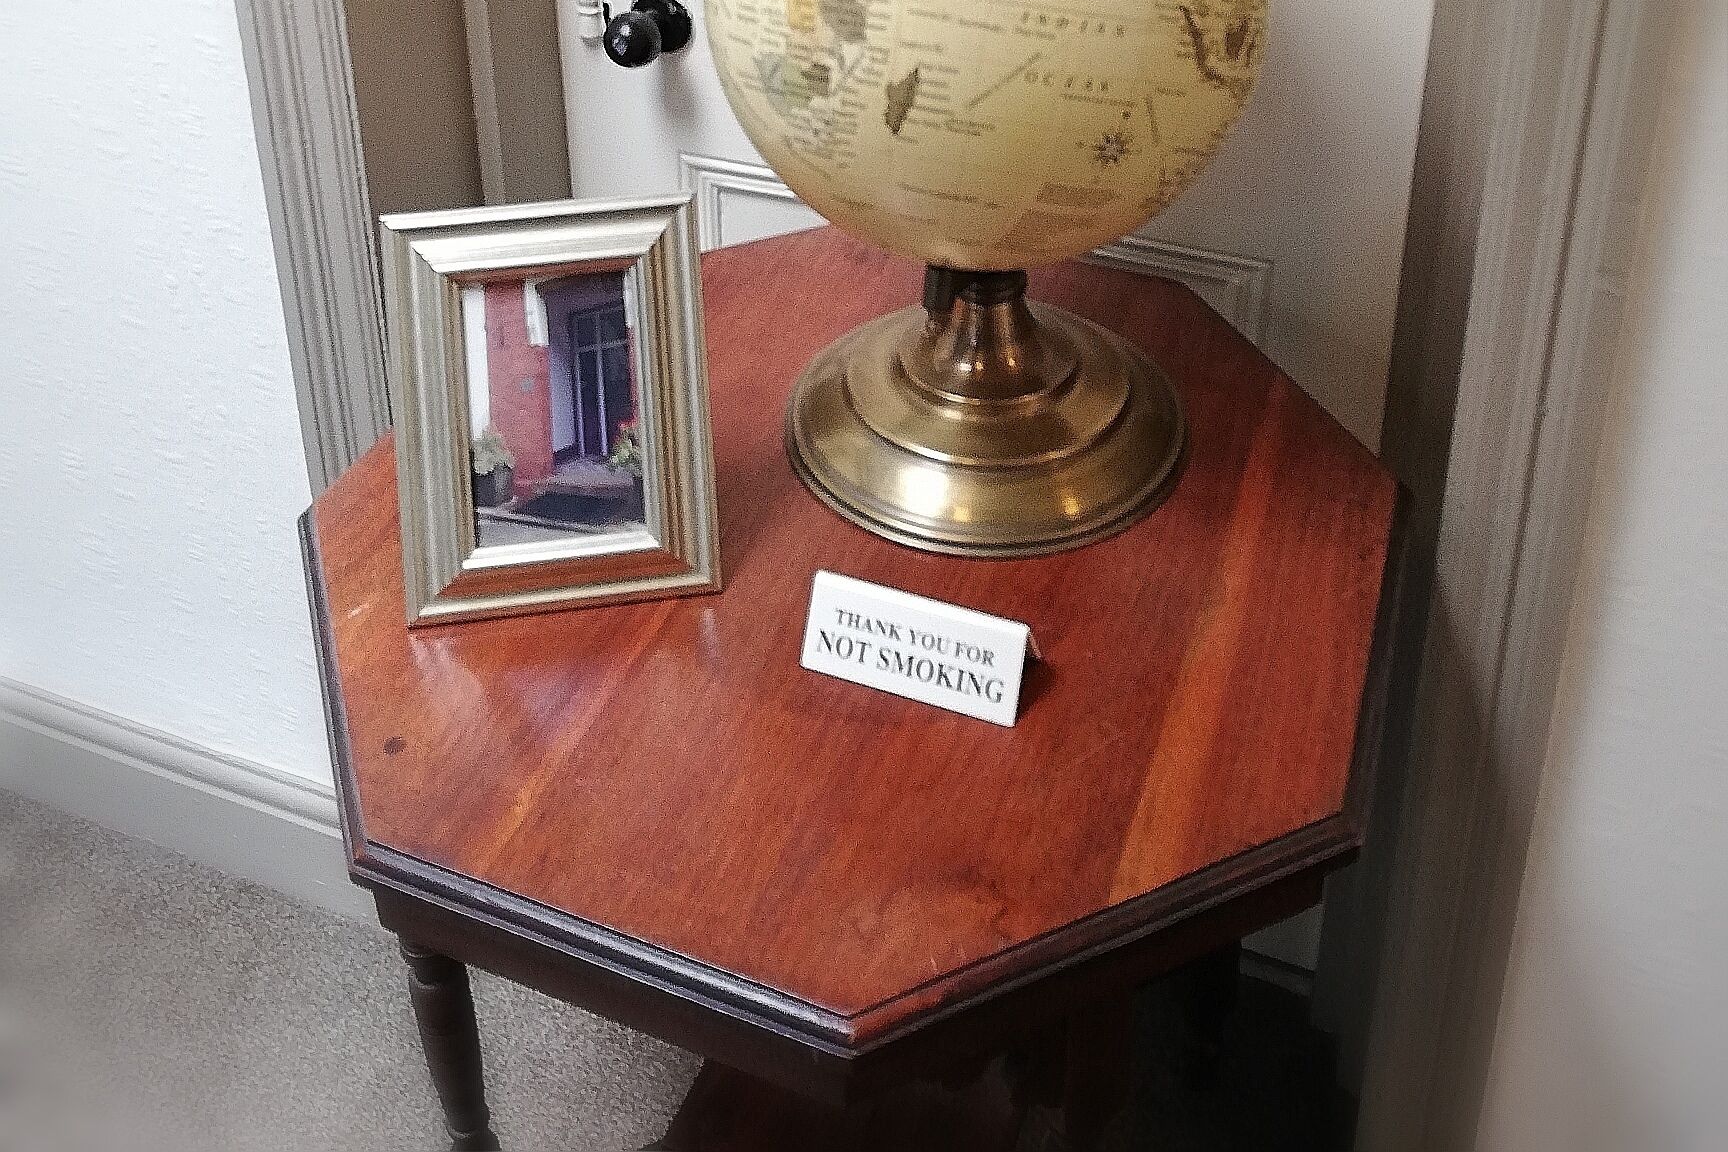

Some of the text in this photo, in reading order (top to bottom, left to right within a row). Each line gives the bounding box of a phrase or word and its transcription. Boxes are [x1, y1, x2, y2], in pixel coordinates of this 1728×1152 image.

[817, 628, 1005, 704] NOT SMOKING
[835, 608, 995, 667] THANK YOU FOR
